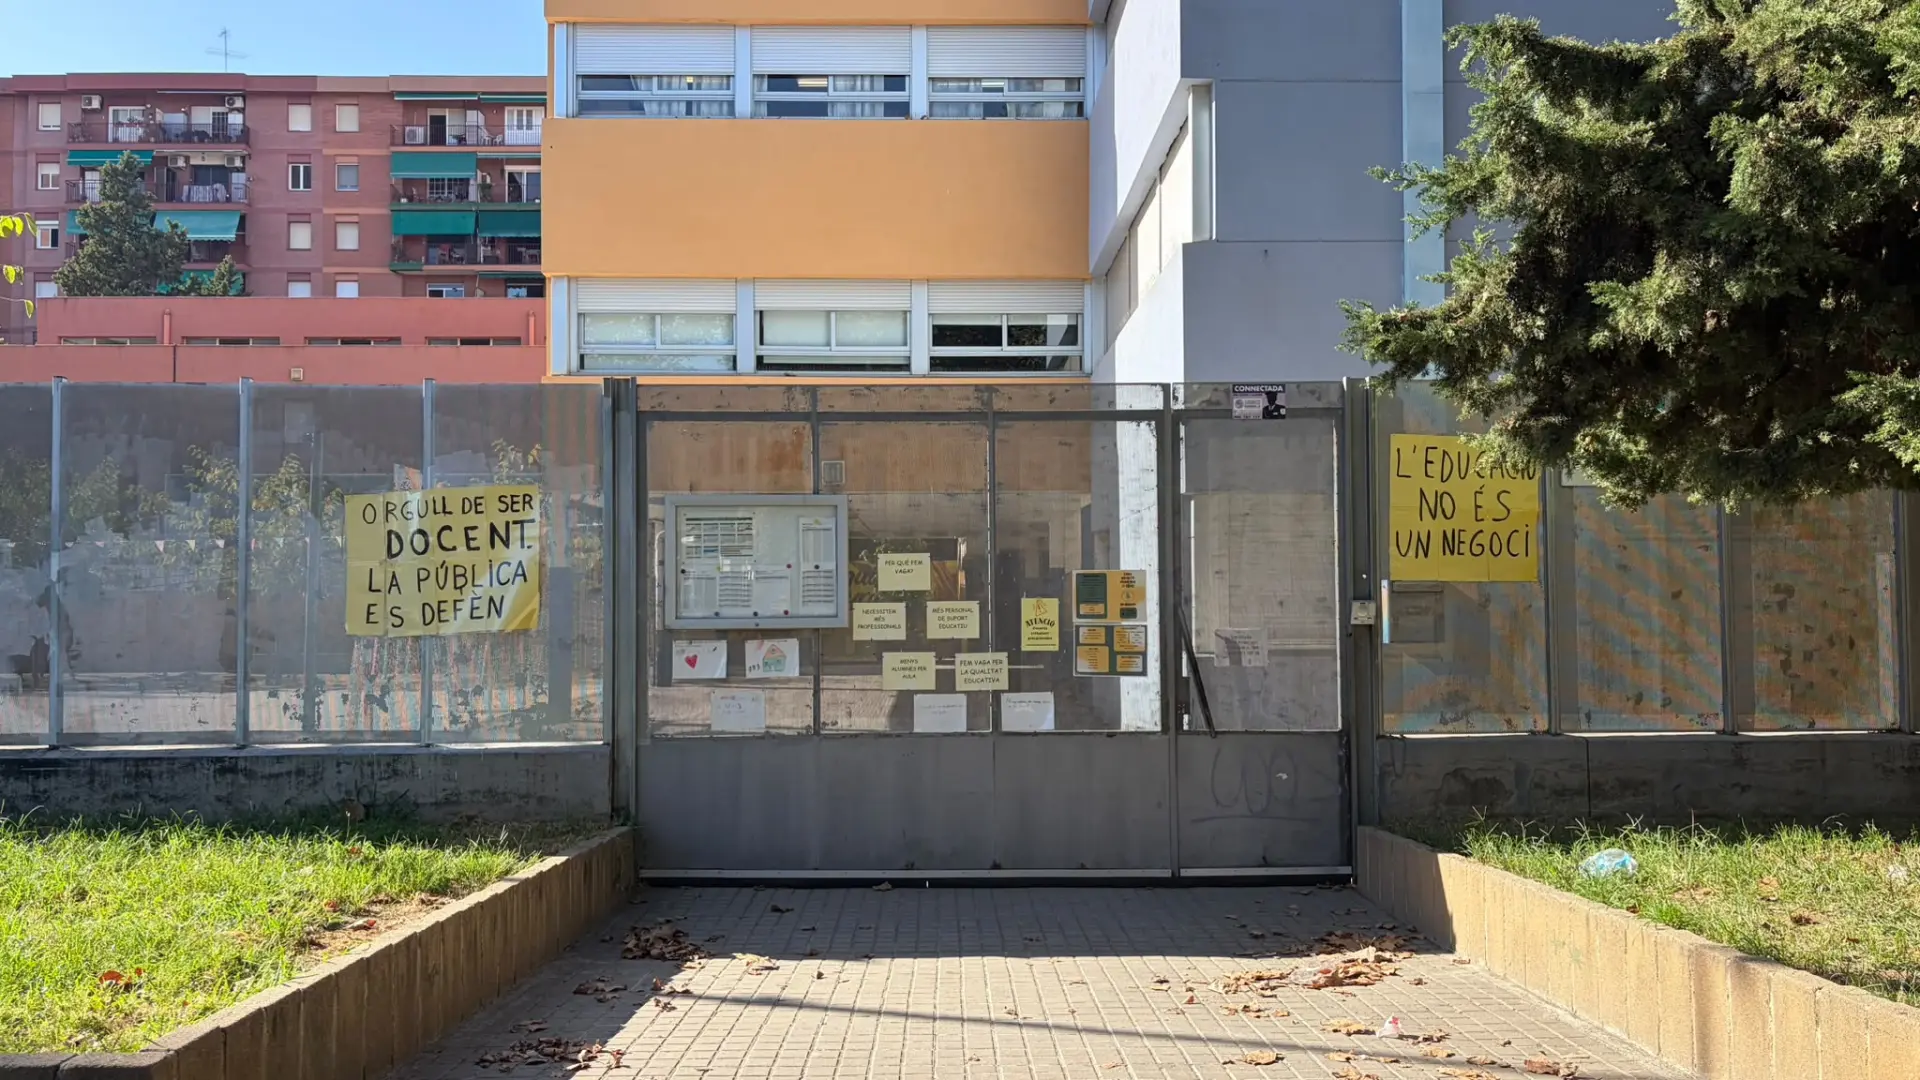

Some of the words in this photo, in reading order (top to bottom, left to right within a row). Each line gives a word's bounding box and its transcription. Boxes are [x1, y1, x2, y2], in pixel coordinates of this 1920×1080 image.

[362, 496, 453, 524] ORGULL
[461, 496, 485, 515] DE
[498, 493, 534, 513] SER
[1419, 487, 1456, 522] NO
[1474, 484, 1511, 522] ÉS
[1396, 529, 1431, 559] UN
[1442, 524, 1530, 558] NEGOCI
[368, 568, 402, 595] LA
[417, 559, 528, 595] PÚBLICA
[366, 603, 405, 628] ES
[422, 590, 505, 626] DEFÈN
[932, 606, 945, 614] MÉS
[960, 659, 973, 667] FEM
[970, 667, 1003, 675] QUALITAT
